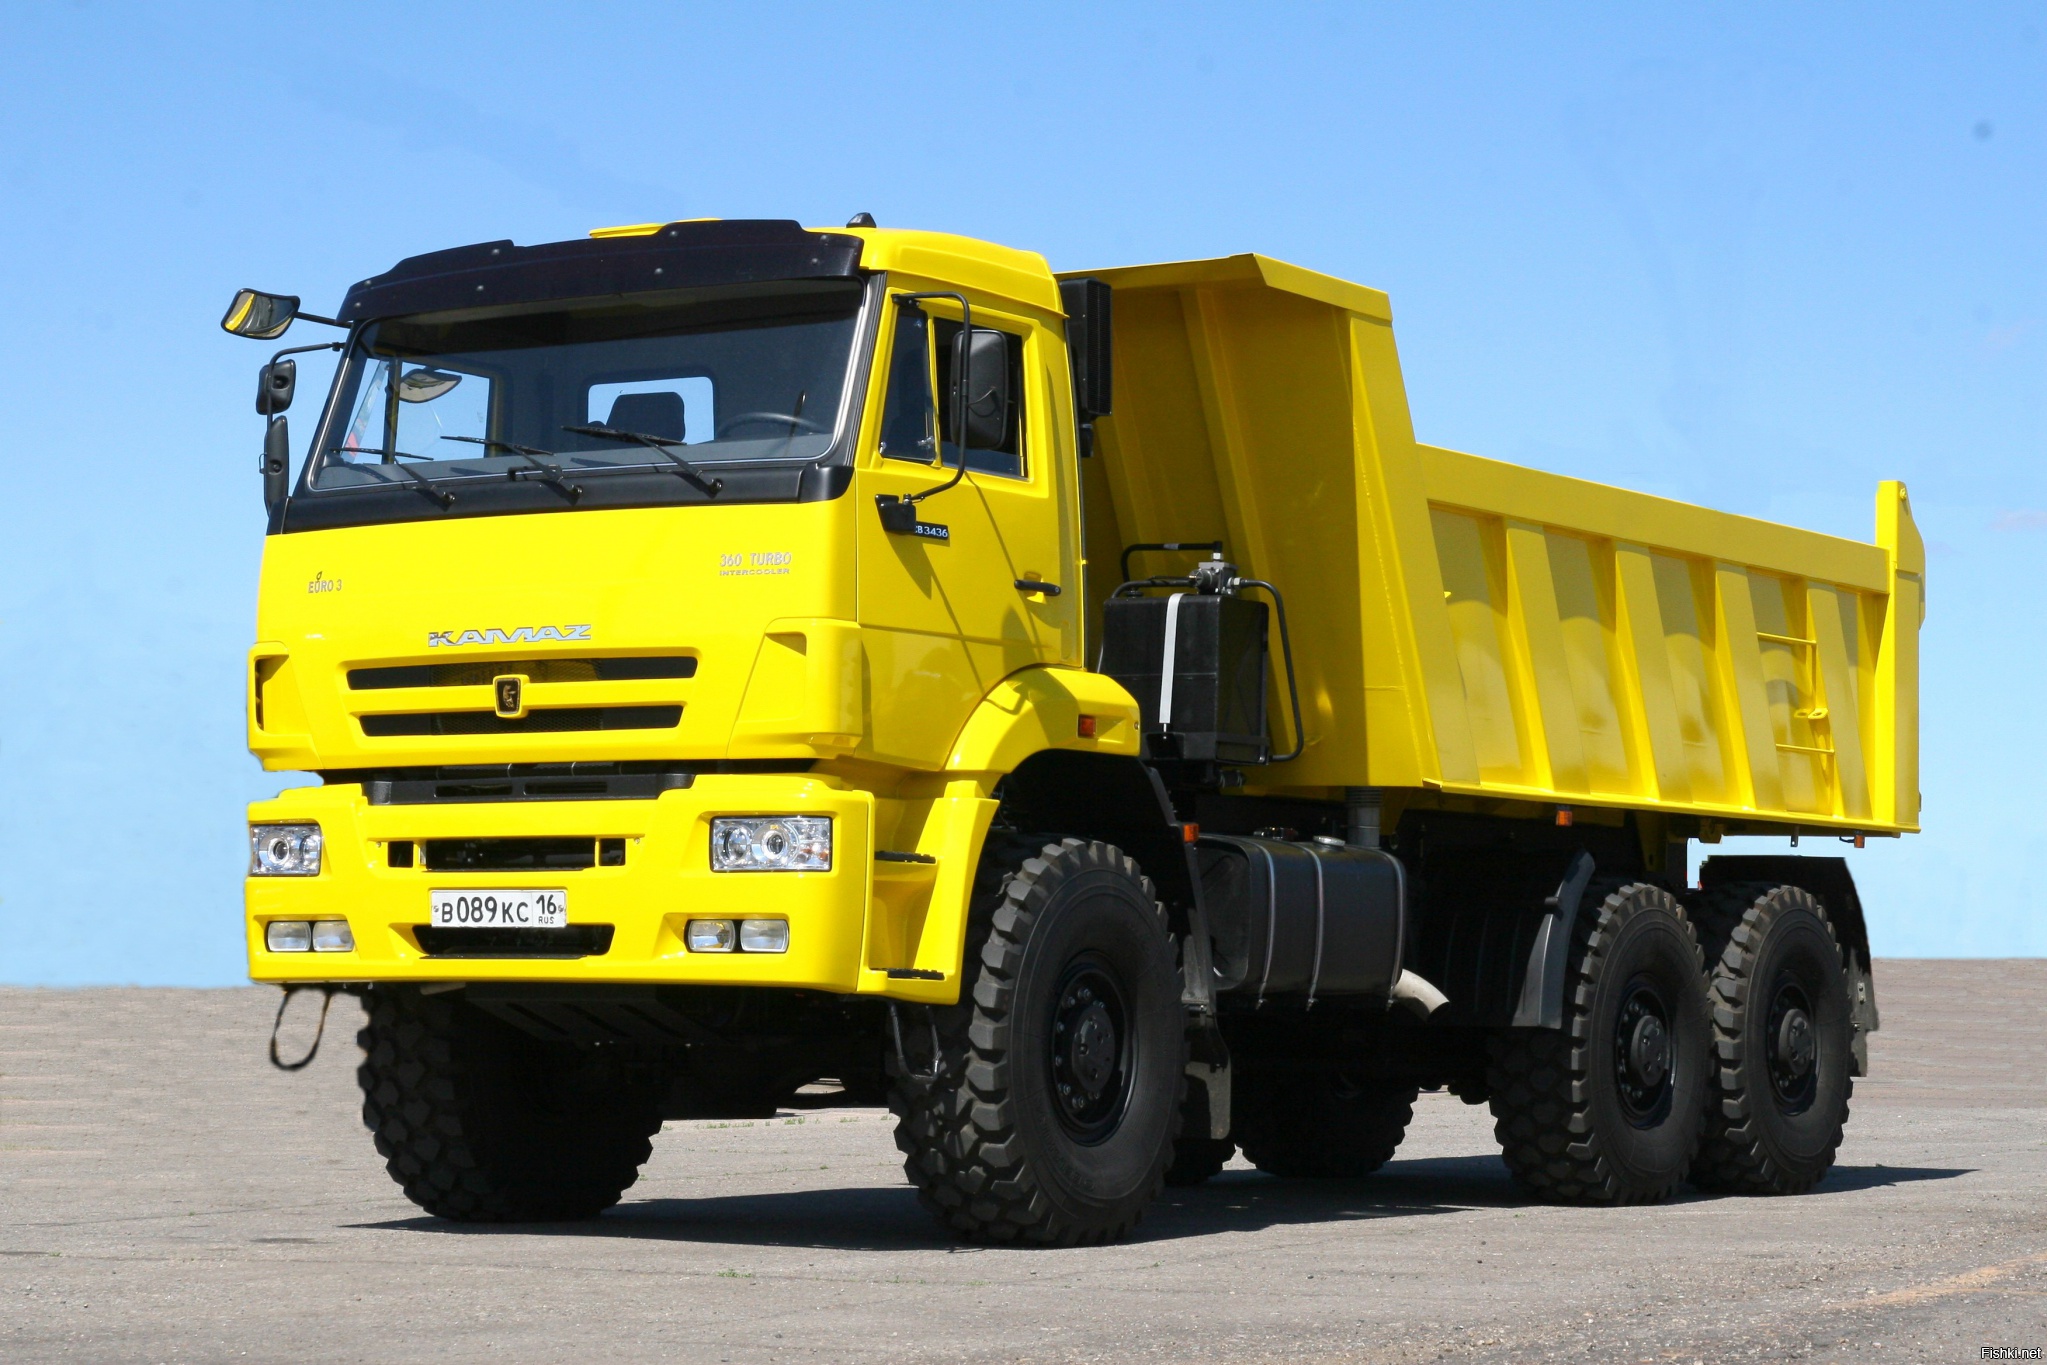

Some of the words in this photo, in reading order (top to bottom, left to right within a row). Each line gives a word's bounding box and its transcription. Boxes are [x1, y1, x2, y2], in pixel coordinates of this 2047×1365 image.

[924, 526, 948, 538] 3436
[720, 553, 742, 567] 360
[750, 552, 792, 566] TURBO
[719, 568, 790, 576] INTERCOOLER
[308, 580, 334, 593] EURO
[336, 579, 342, 592] 3
[428, 624, 591, 647] KAMAZ
[536, 894, 557, 915] 16
[538, 916, 554, 924] RUS
